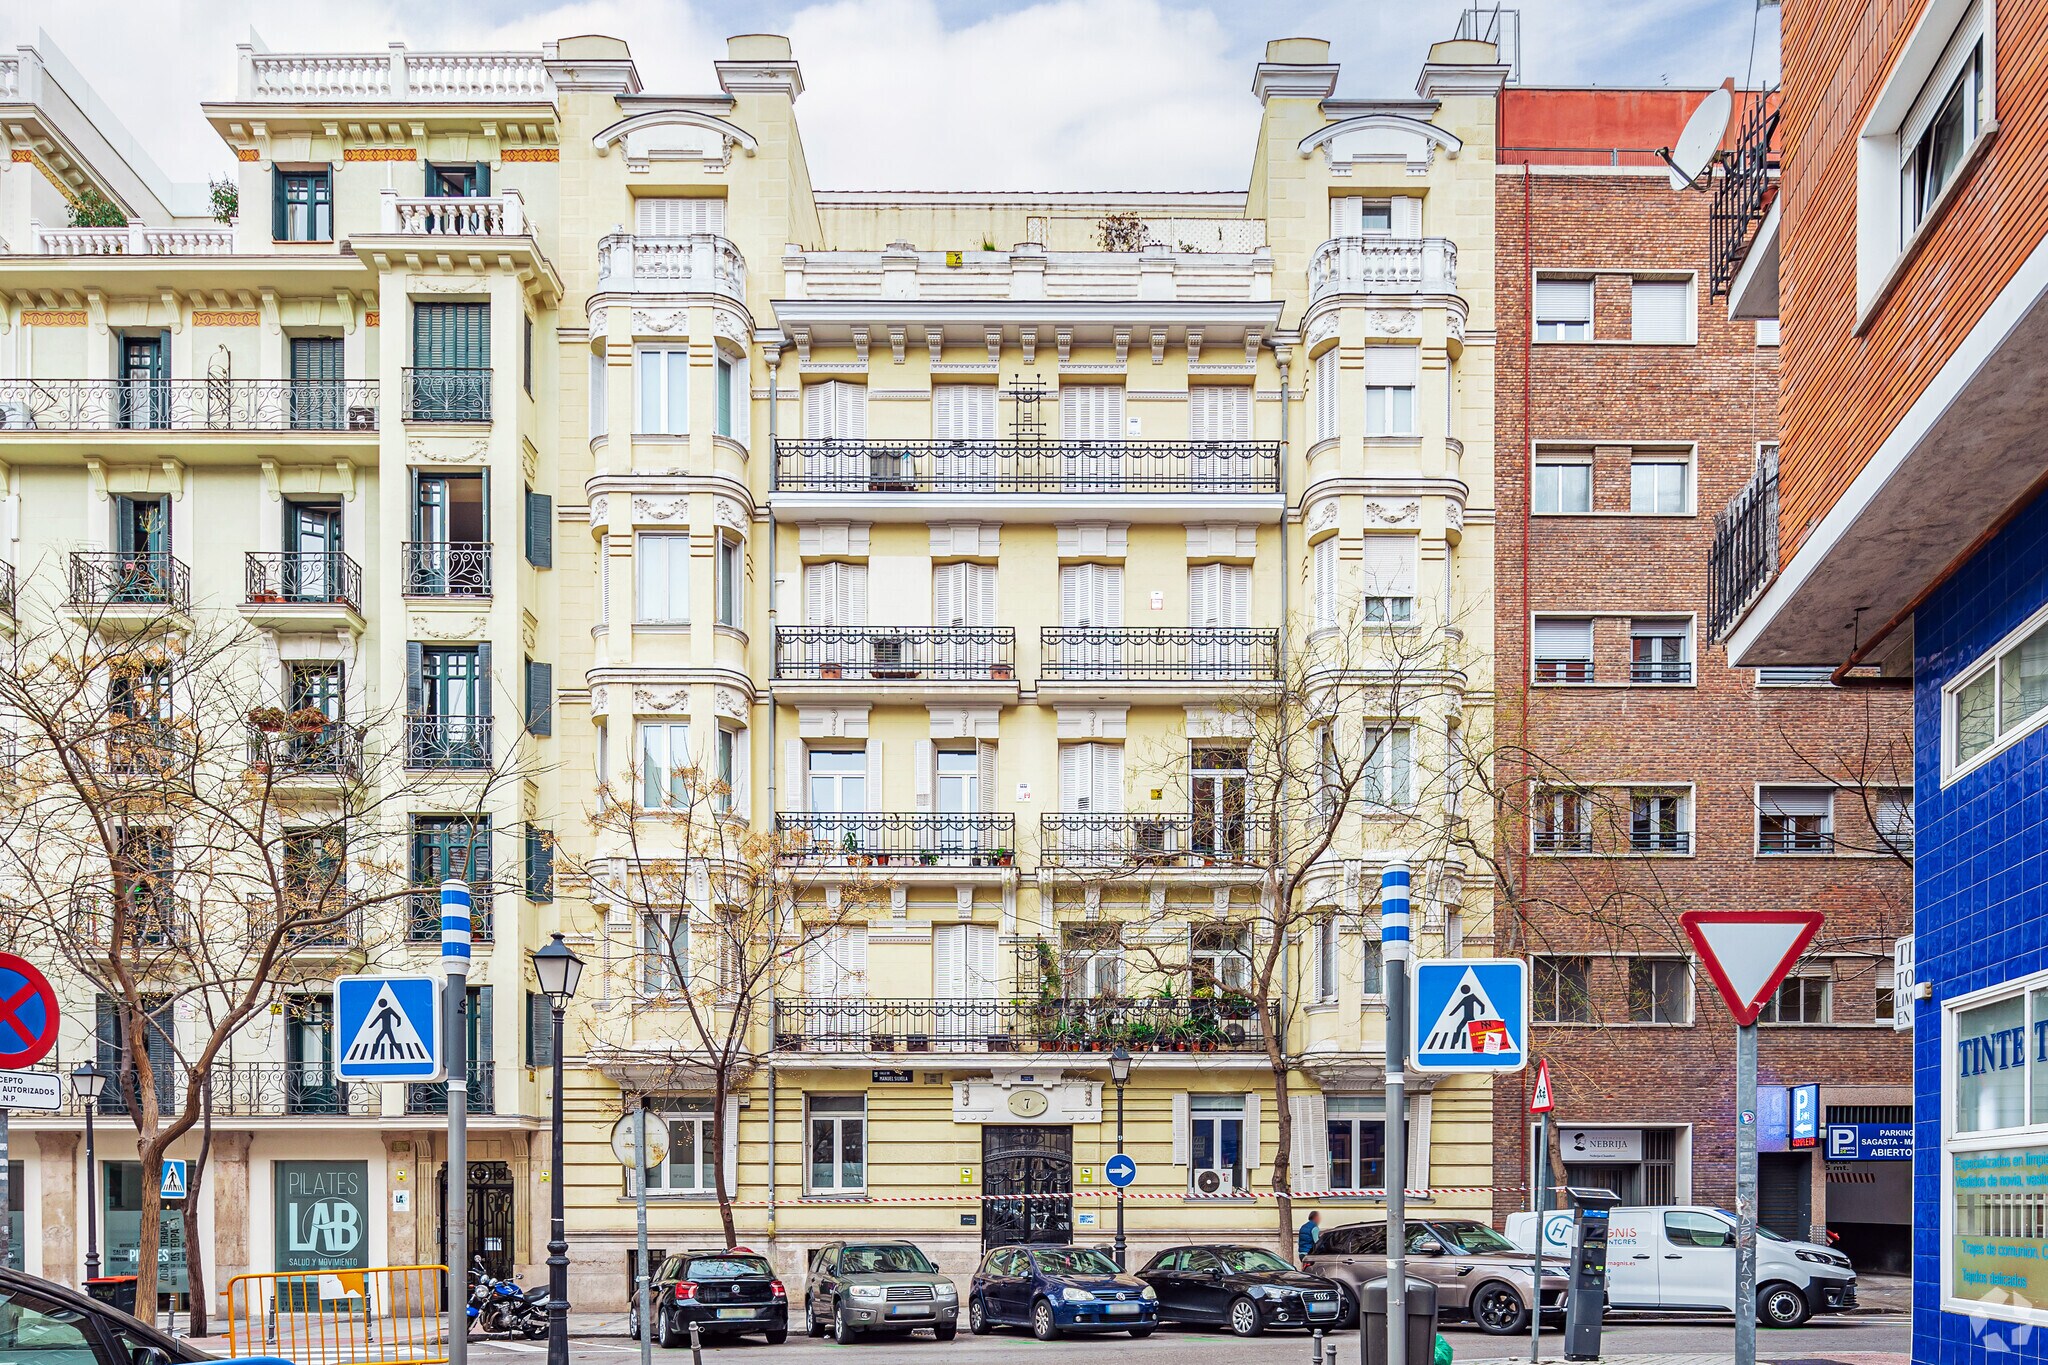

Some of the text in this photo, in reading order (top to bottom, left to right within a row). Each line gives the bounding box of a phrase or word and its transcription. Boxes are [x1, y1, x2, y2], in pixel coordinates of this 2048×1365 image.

[3, 1086, 54, 1096] AUTORIZADOS
[1024, 1098, 1030, 1109] 7
[1590, 1141, 1628, 1149] NEBRIJA
[1832, 1129, 1854, 1154] P
[1870, 1148, 1912, 1157] ABIERTO
[1955, 1155, 2010, 1172] Especializados
[2013, 1156, 2023, 1167] en
[289, 1172, 358, 1194] PILATES
[1955, 1175, 1986, 1188] Vestidos
[1988, 1174, 1997, 1187] de
[289, 1202, 358, 1251] LAB
[130, 1249, 169, 1261] PIES
[1962, 1240, 1984, 1257] Trajes
[1986, 1243, 1996, 1256] de
[289, 1258, 358, 1266] SALUD Y MOVIMIENTO
[1962, 1268, 2027, 1288] Tejidos delicados
